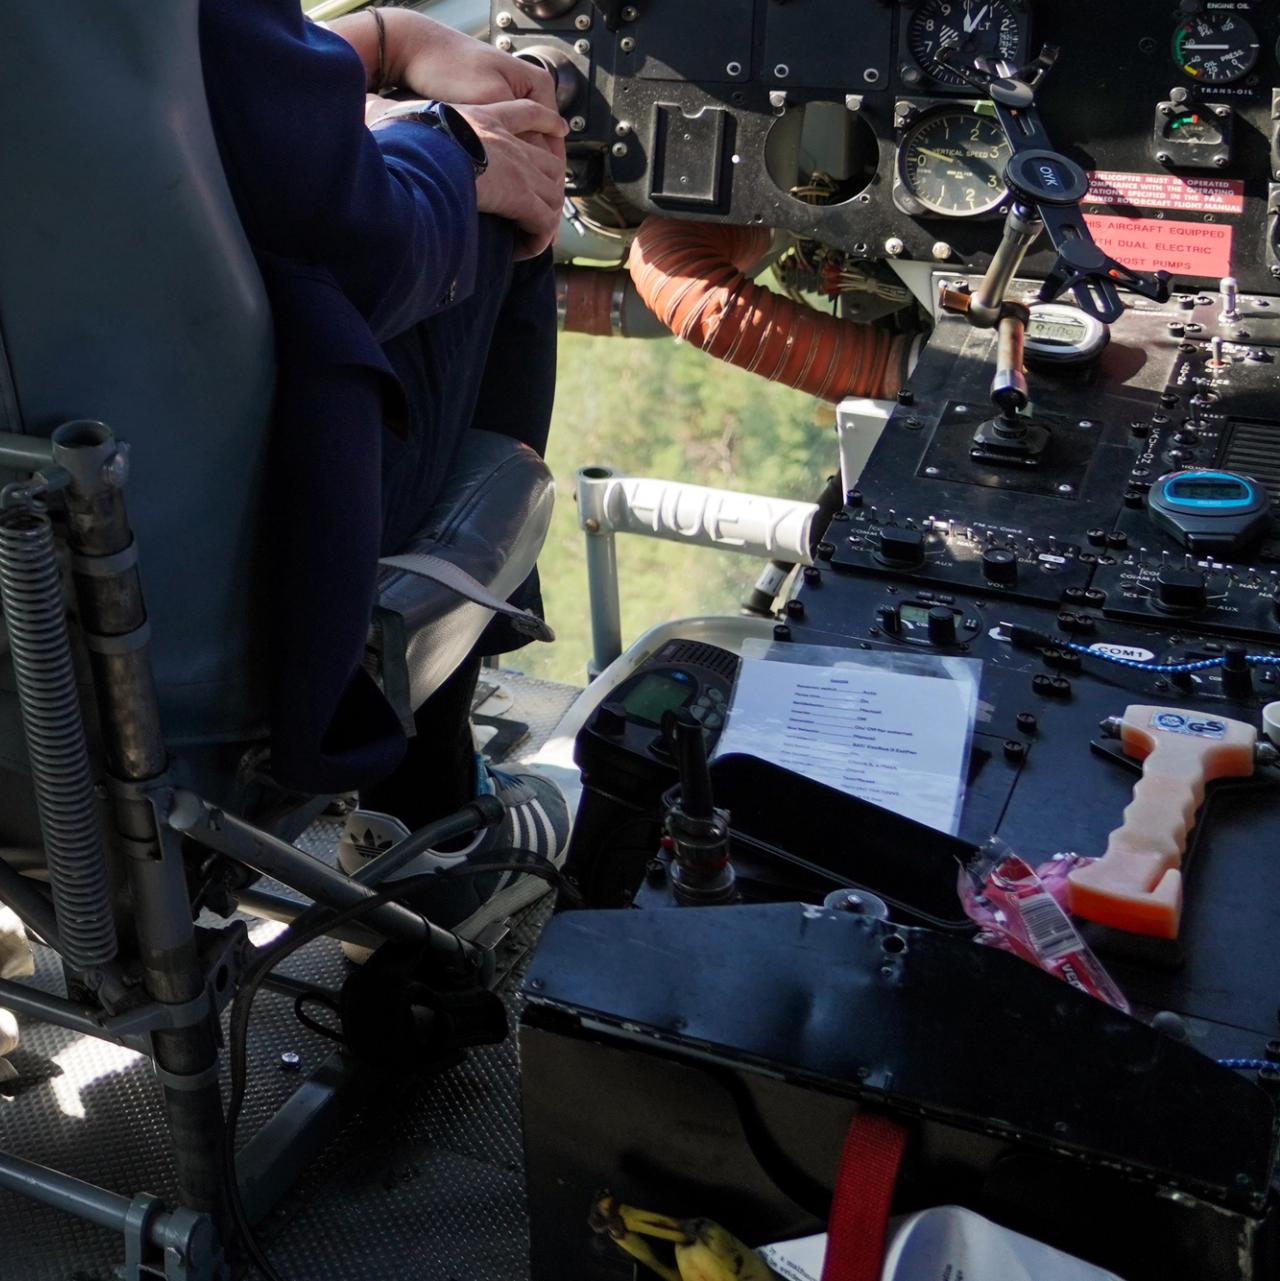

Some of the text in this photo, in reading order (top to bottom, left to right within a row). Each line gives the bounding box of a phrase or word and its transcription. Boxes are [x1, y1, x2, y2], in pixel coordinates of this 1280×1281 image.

[941, 3, 952, 17] 9
[1206, 2, 1251, 10] ENGINE OIL
[925, 19, 935, 32] 8
[1000, 18, 1010, 32] 2
[923, 40, 933, 54] 7
[1201, 87, 1254, 96] TRANS-OIL
[970, 128, 980, 141] 2
[966, 150, 989, 159] SPEED
[990, 146, 999, 159] 3
[918, 155, 926, 166] 0
[987, 175, 997, 188] 3
[1040, 166, 1059, 186] OYK
[1095, 173, 1141, 183] HELICOPTER
[1146, 176, 1168, 185] MUST
[1187, 179, 1230, 188] OPERATED
[965, 188, 976, 201] 2
[1127, 190, 1166, 199] SPECIFIED
[1170, 192, 1180, 200] IN
[1184, 193, 1199, 201] THE
[1140, 183, 1163, 192] WITH
[1167, 185, 1183, 193] THE
[1186, 186, 1234, 196] OPERATING
[1117, 197, 1241, 211] ROTORCRAFT FLIGHT MANUAL
[1107, 222, 1163, 234] AIRCRAFT
[1169, 227, 1225, 239] EQUIPPED
[1118, 240, 1149, 249] DUAL
[1155, 243, 1212, 255] ELECTRIC
[1113, 256, 1192, 270] OOST PUMPS
[1217, 605, 1240, 613] AUX
[1097, 646, 1143, 658] COM1
